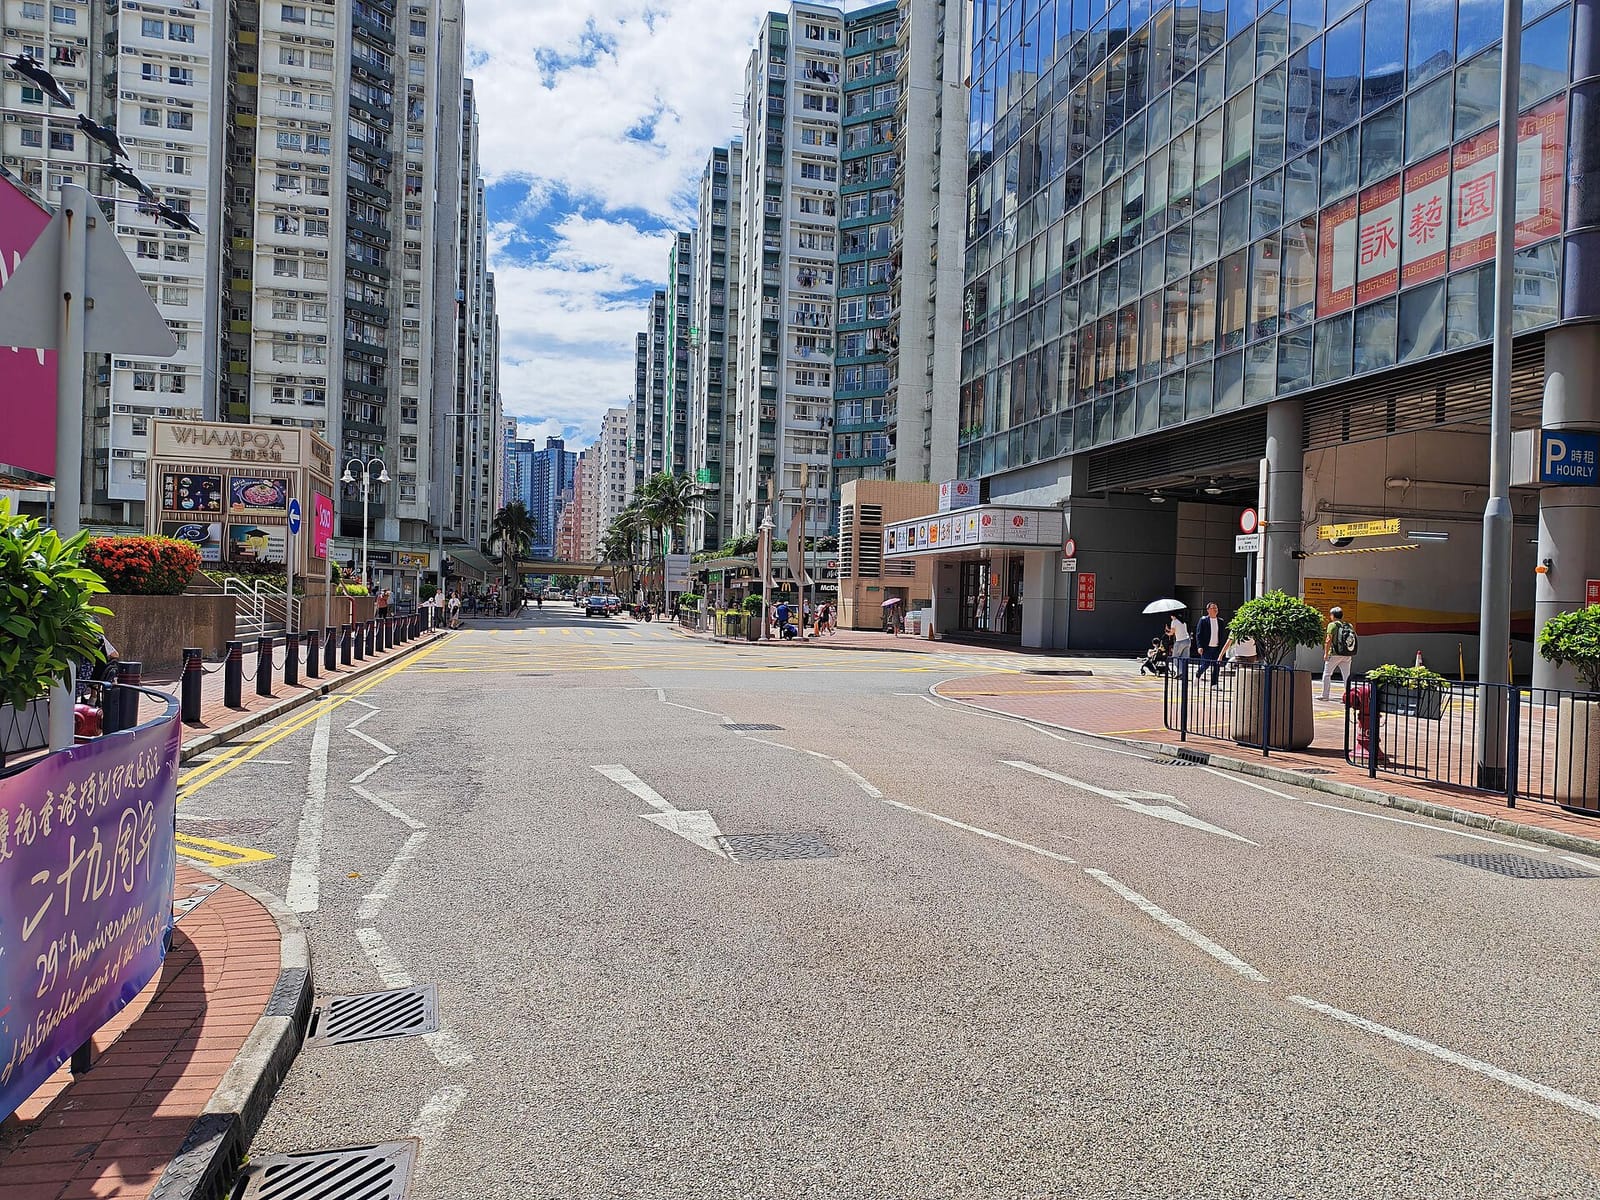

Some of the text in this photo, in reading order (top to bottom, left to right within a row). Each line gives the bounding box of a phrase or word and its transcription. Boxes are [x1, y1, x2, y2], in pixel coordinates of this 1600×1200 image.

[171, 426, 285, 450] WHAMPOA
[1546, 439, 1567, 475] P
[1557, 465, 1594, 477] HOURLY
[1571, 450, 1594, 464] 時租
[22, 800, 156, 941] 二十九周年
[67, 902, 144, 979] Anniversary
[1, 1038, 18, 1087] of
[18, 1024, 35, 1066] the
[36, 960, 111, 1048] Establishment
[111, 945, 123, 983] of
[123, 936, 136, 968] the
